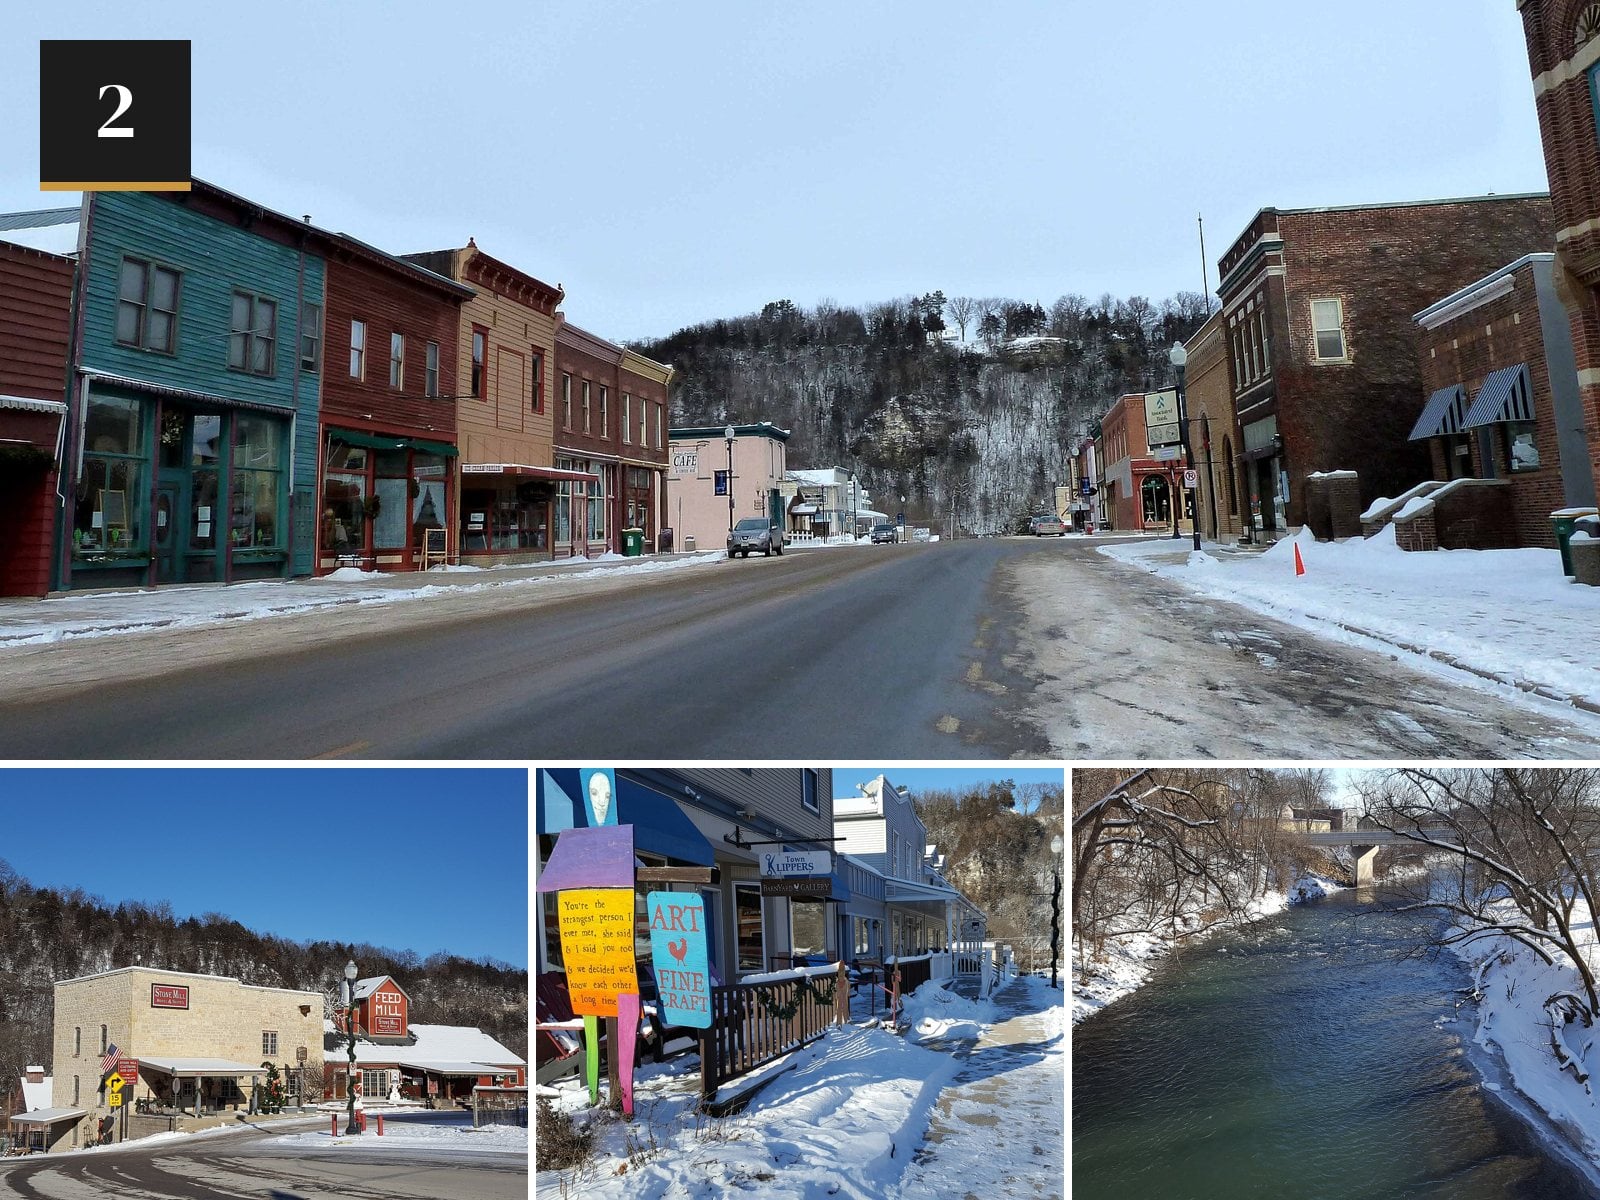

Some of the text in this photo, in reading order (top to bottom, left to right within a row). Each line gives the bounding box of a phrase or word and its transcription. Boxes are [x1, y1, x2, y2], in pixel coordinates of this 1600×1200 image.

[673, 456, 696, 466] CAFE
[800, 883, 829, 891] GALLERY
[564, 900, 605, 910] You're the
[563, 915, 594, 926] strangest
[599, 914, 624, 924] person
[650, 904, 703, 932] ART
[602, 929, 614, 938] she
[616, 929, 631, 938] said
[582, 944, 597, 953] said
[602, 943, 615, 955] you
[588, 965, 615, 974] decided
[618, 965, 634, 974] we'd
[569, 980, 632, 989] know each other
[658, 970, 704, 992] FINE
[375, 992, 401, 1003] FEED
[581, 995, 596, 1007] long
[601, 996, 616, 1005] time
[660, 992, 708, 1012] CRAFT
[375, 1005, 402, 1015] MILL
